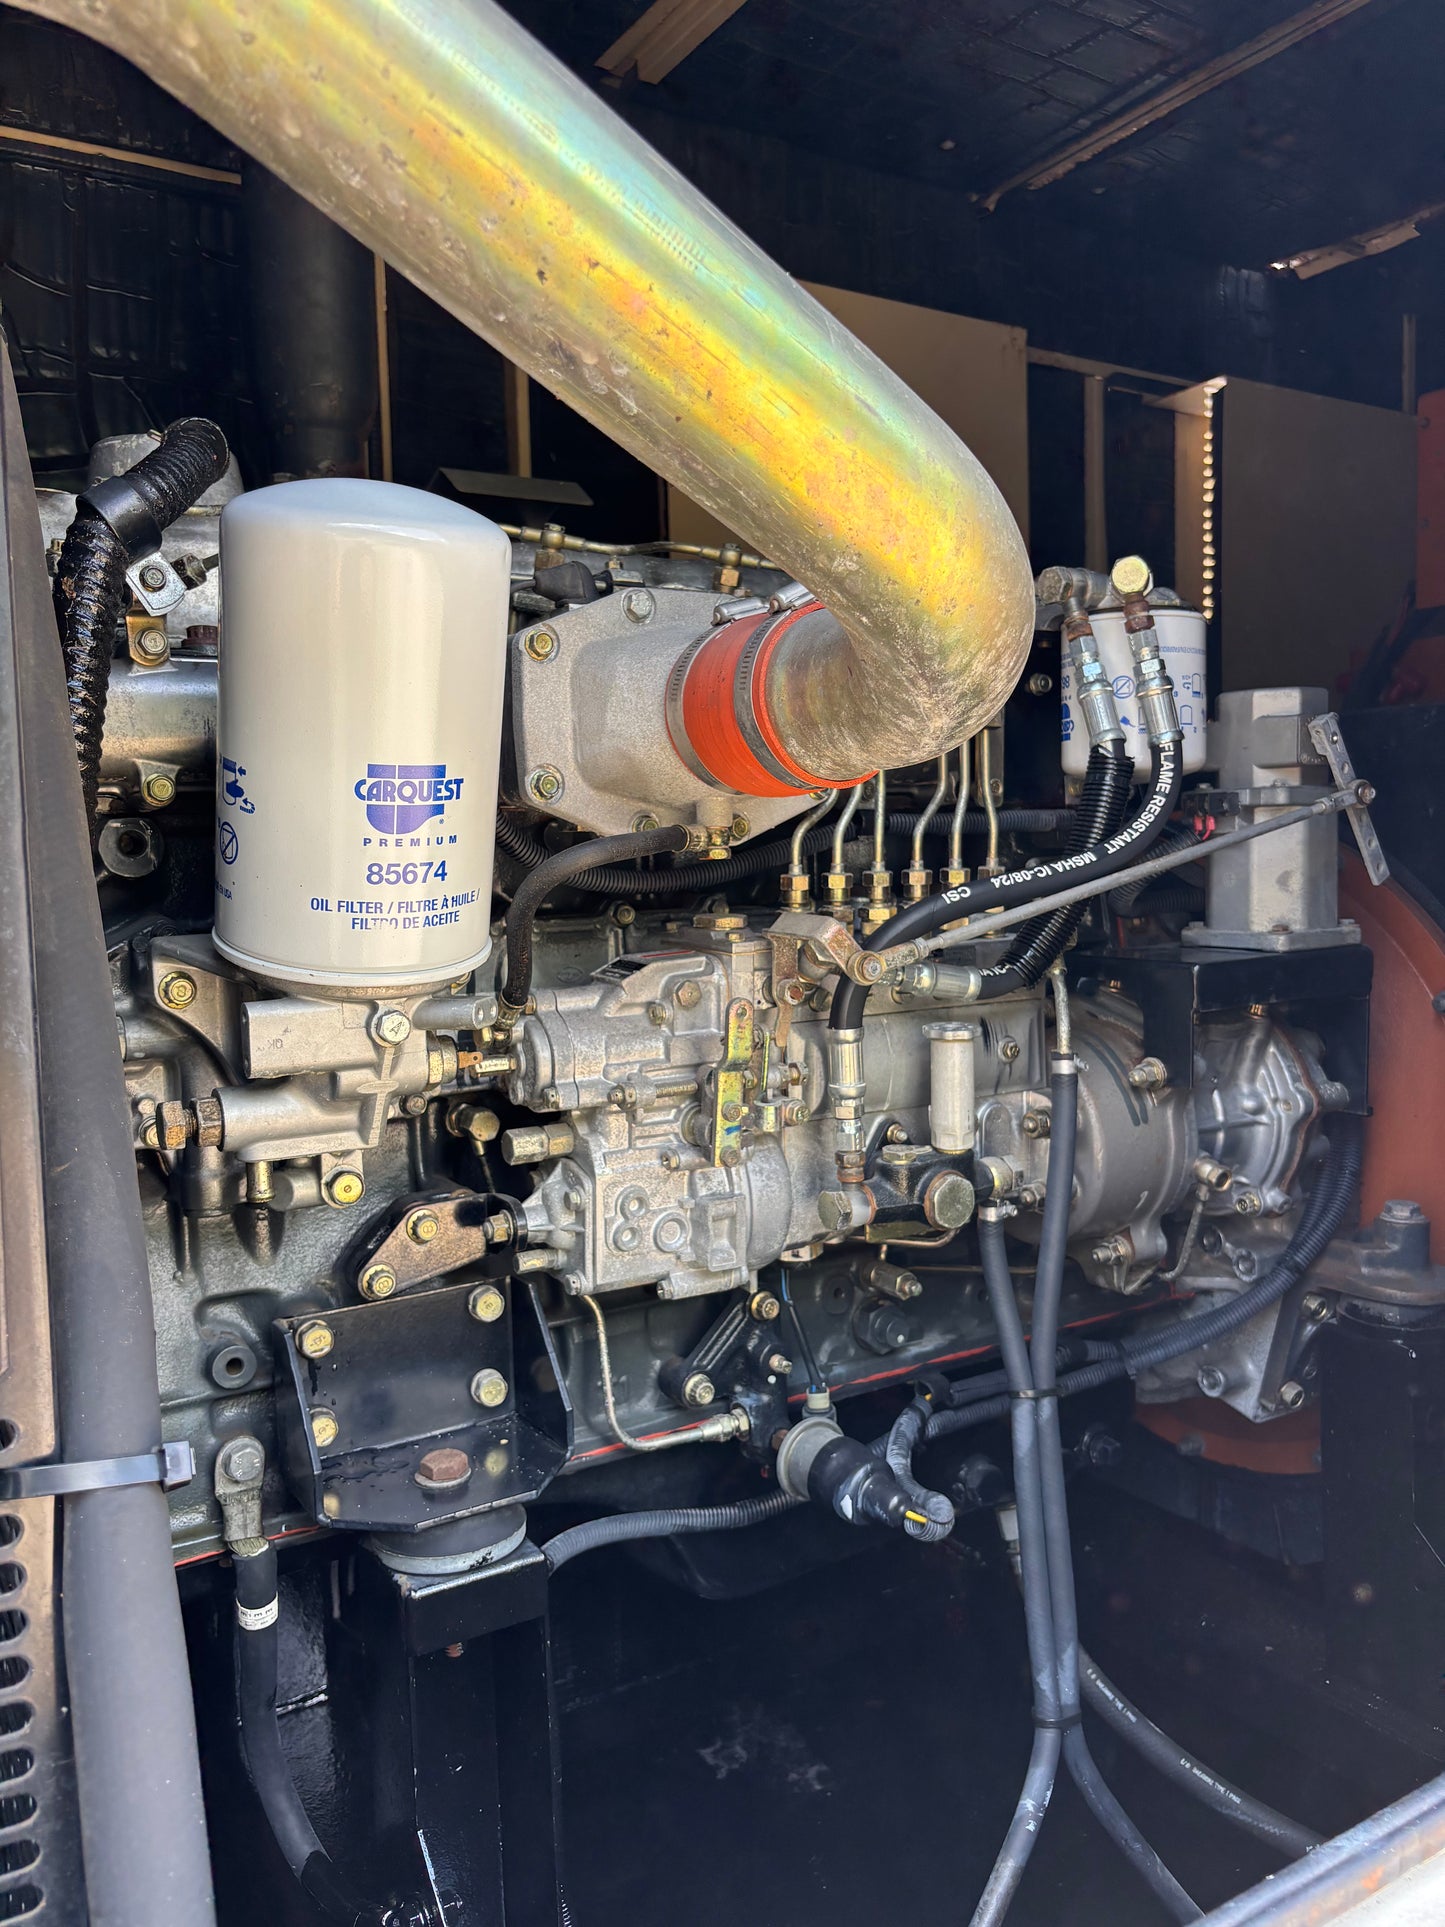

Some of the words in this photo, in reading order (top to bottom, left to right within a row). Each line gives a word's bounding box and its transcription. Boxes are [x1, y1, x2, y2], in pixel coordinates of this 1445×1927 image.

[1156, 742, 1175, 794] FLAME
[354, 778, 464, 804] CARQUEST
[1104, 795, 1167, 854] RESISTANT
[363, 834, 457, 847] PREMIUM
[366, 860, 448, 886] 85674
[1050, 851, 1097, 873] MSHA
[990, 865, 1052, 889] IC-08/24
[310, 897, 332, 912] OIL
[337, 900, 383, 914] FILTER
[397, 898, 438, 914] FILTRE
[441, 894, 449, 909] À
[450, 890, 476, 908] HUILE
[941, 885, 971, 904] CSI
[402, 917, 419, 929] DE
[422, 910, 460, 928] ACEITE
